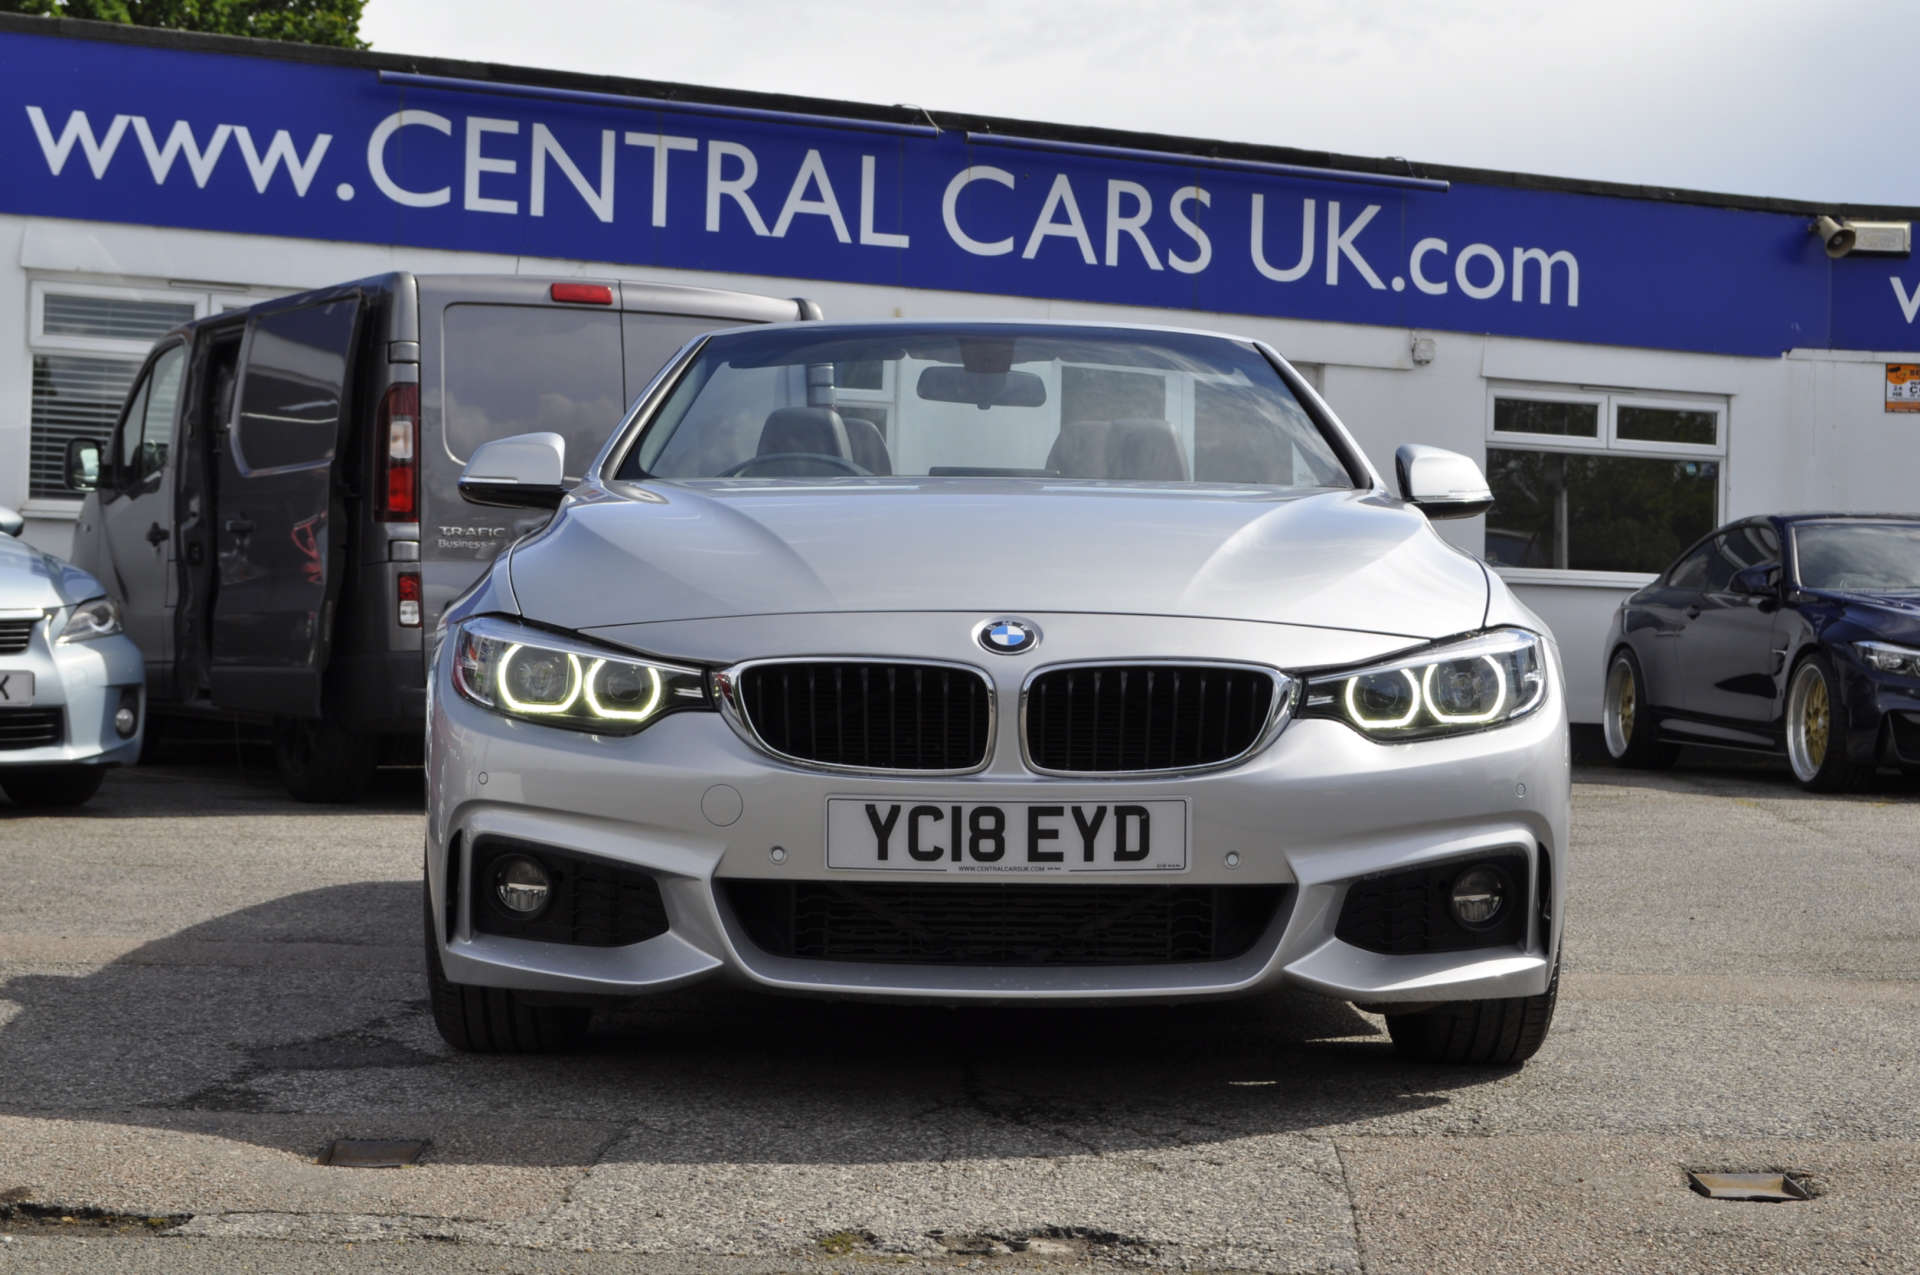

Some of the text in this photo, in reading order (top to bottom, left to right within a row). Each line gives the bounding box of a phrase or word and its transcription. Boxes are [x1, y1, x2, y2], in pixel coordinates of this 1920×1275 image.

[942, 165, 1212, 274] CARS
[1249, 193, 1580, 307] UK.com
[438, 526, 505, 536] TRAFIC
[864, 803, 1151, 863] YC18 EYD
